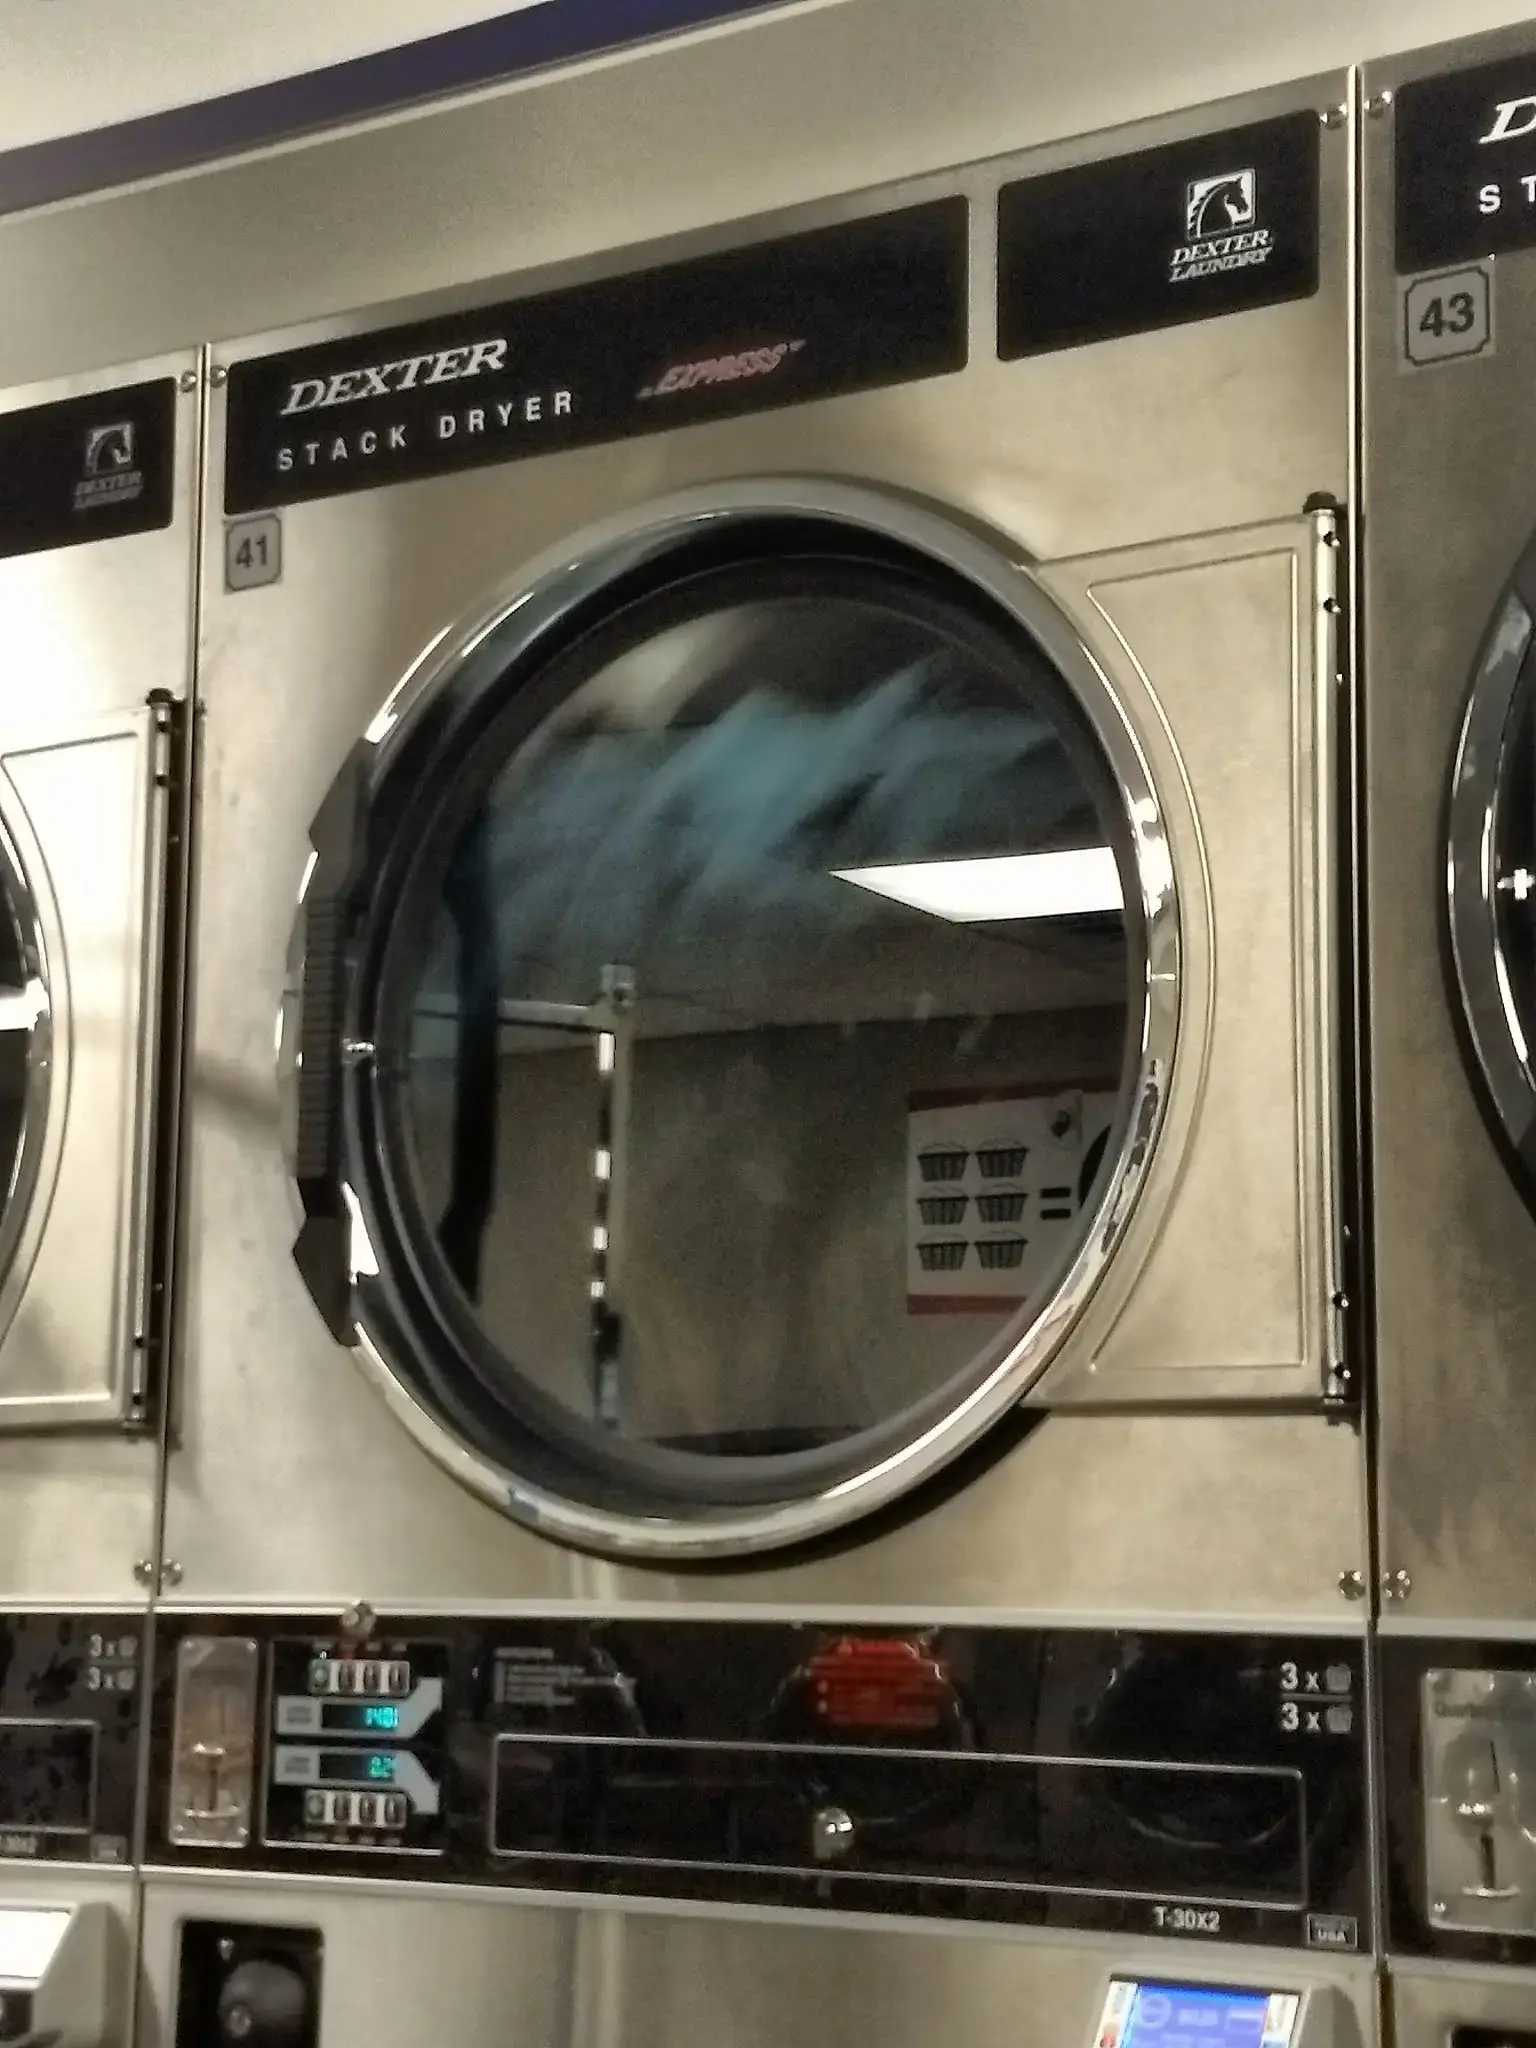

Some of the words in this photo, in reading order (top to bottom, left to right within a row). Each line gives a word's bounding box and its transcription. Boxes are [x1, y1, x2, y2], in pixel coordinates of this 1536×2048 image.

[1167, 246, 1273, 283] LAUNDRY
[1169, 229, 1270, 267] DEXTER
[1420, 291, 1475, 338] 43
[280, 339, 508, 416] DEXTER
[276, 424, 407, 472] STACK
[439, 389, 573, 439] DRYER
[235, 534, 267, 569] 41
[1281, 1661, 1299, 1690] 3
[1281, 1701, 1299, 1732] 3
